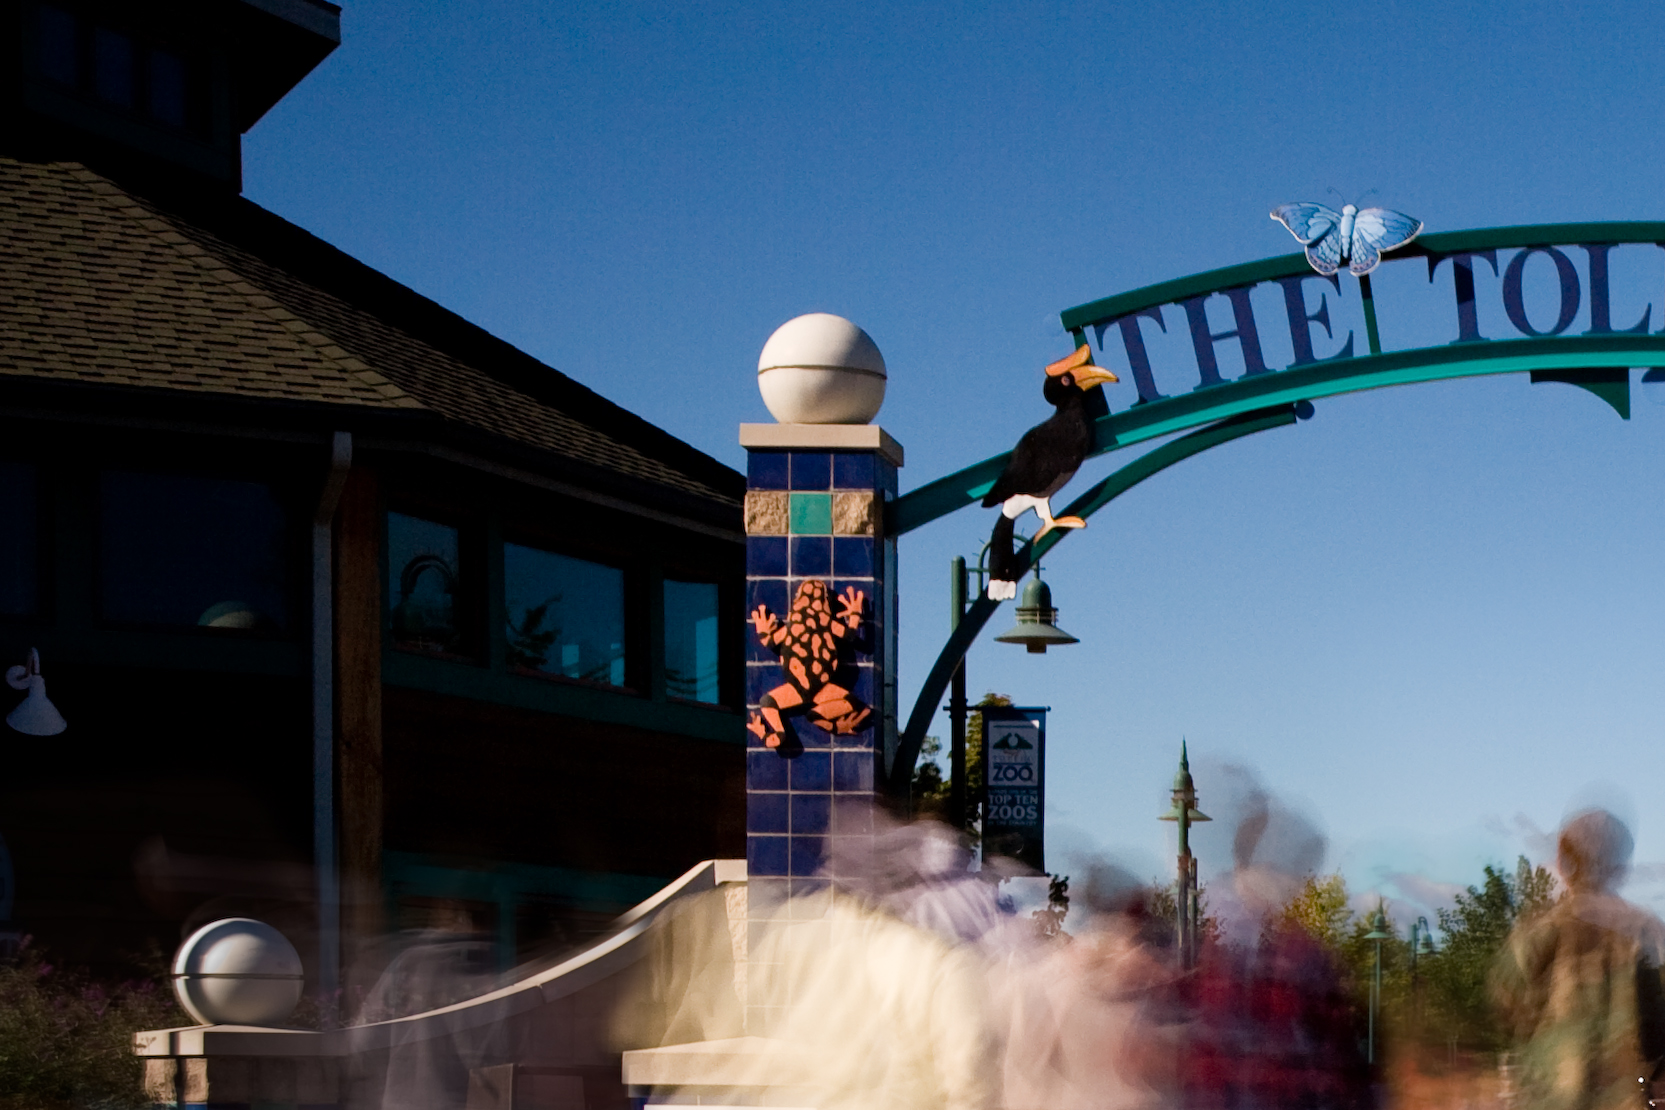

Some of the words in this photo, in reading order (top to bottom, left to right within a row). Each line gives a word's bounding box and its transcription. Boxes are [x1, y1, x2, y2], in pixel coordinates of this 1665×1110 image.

[1093, 273, 1354, 408] THE
[993, 764, 1033, 781] ZOO
[988, 795, 1012, 805] TOP
[1015, 795, 1038, 805] TEN
[988, 806, 1038, 820] ZOOS
